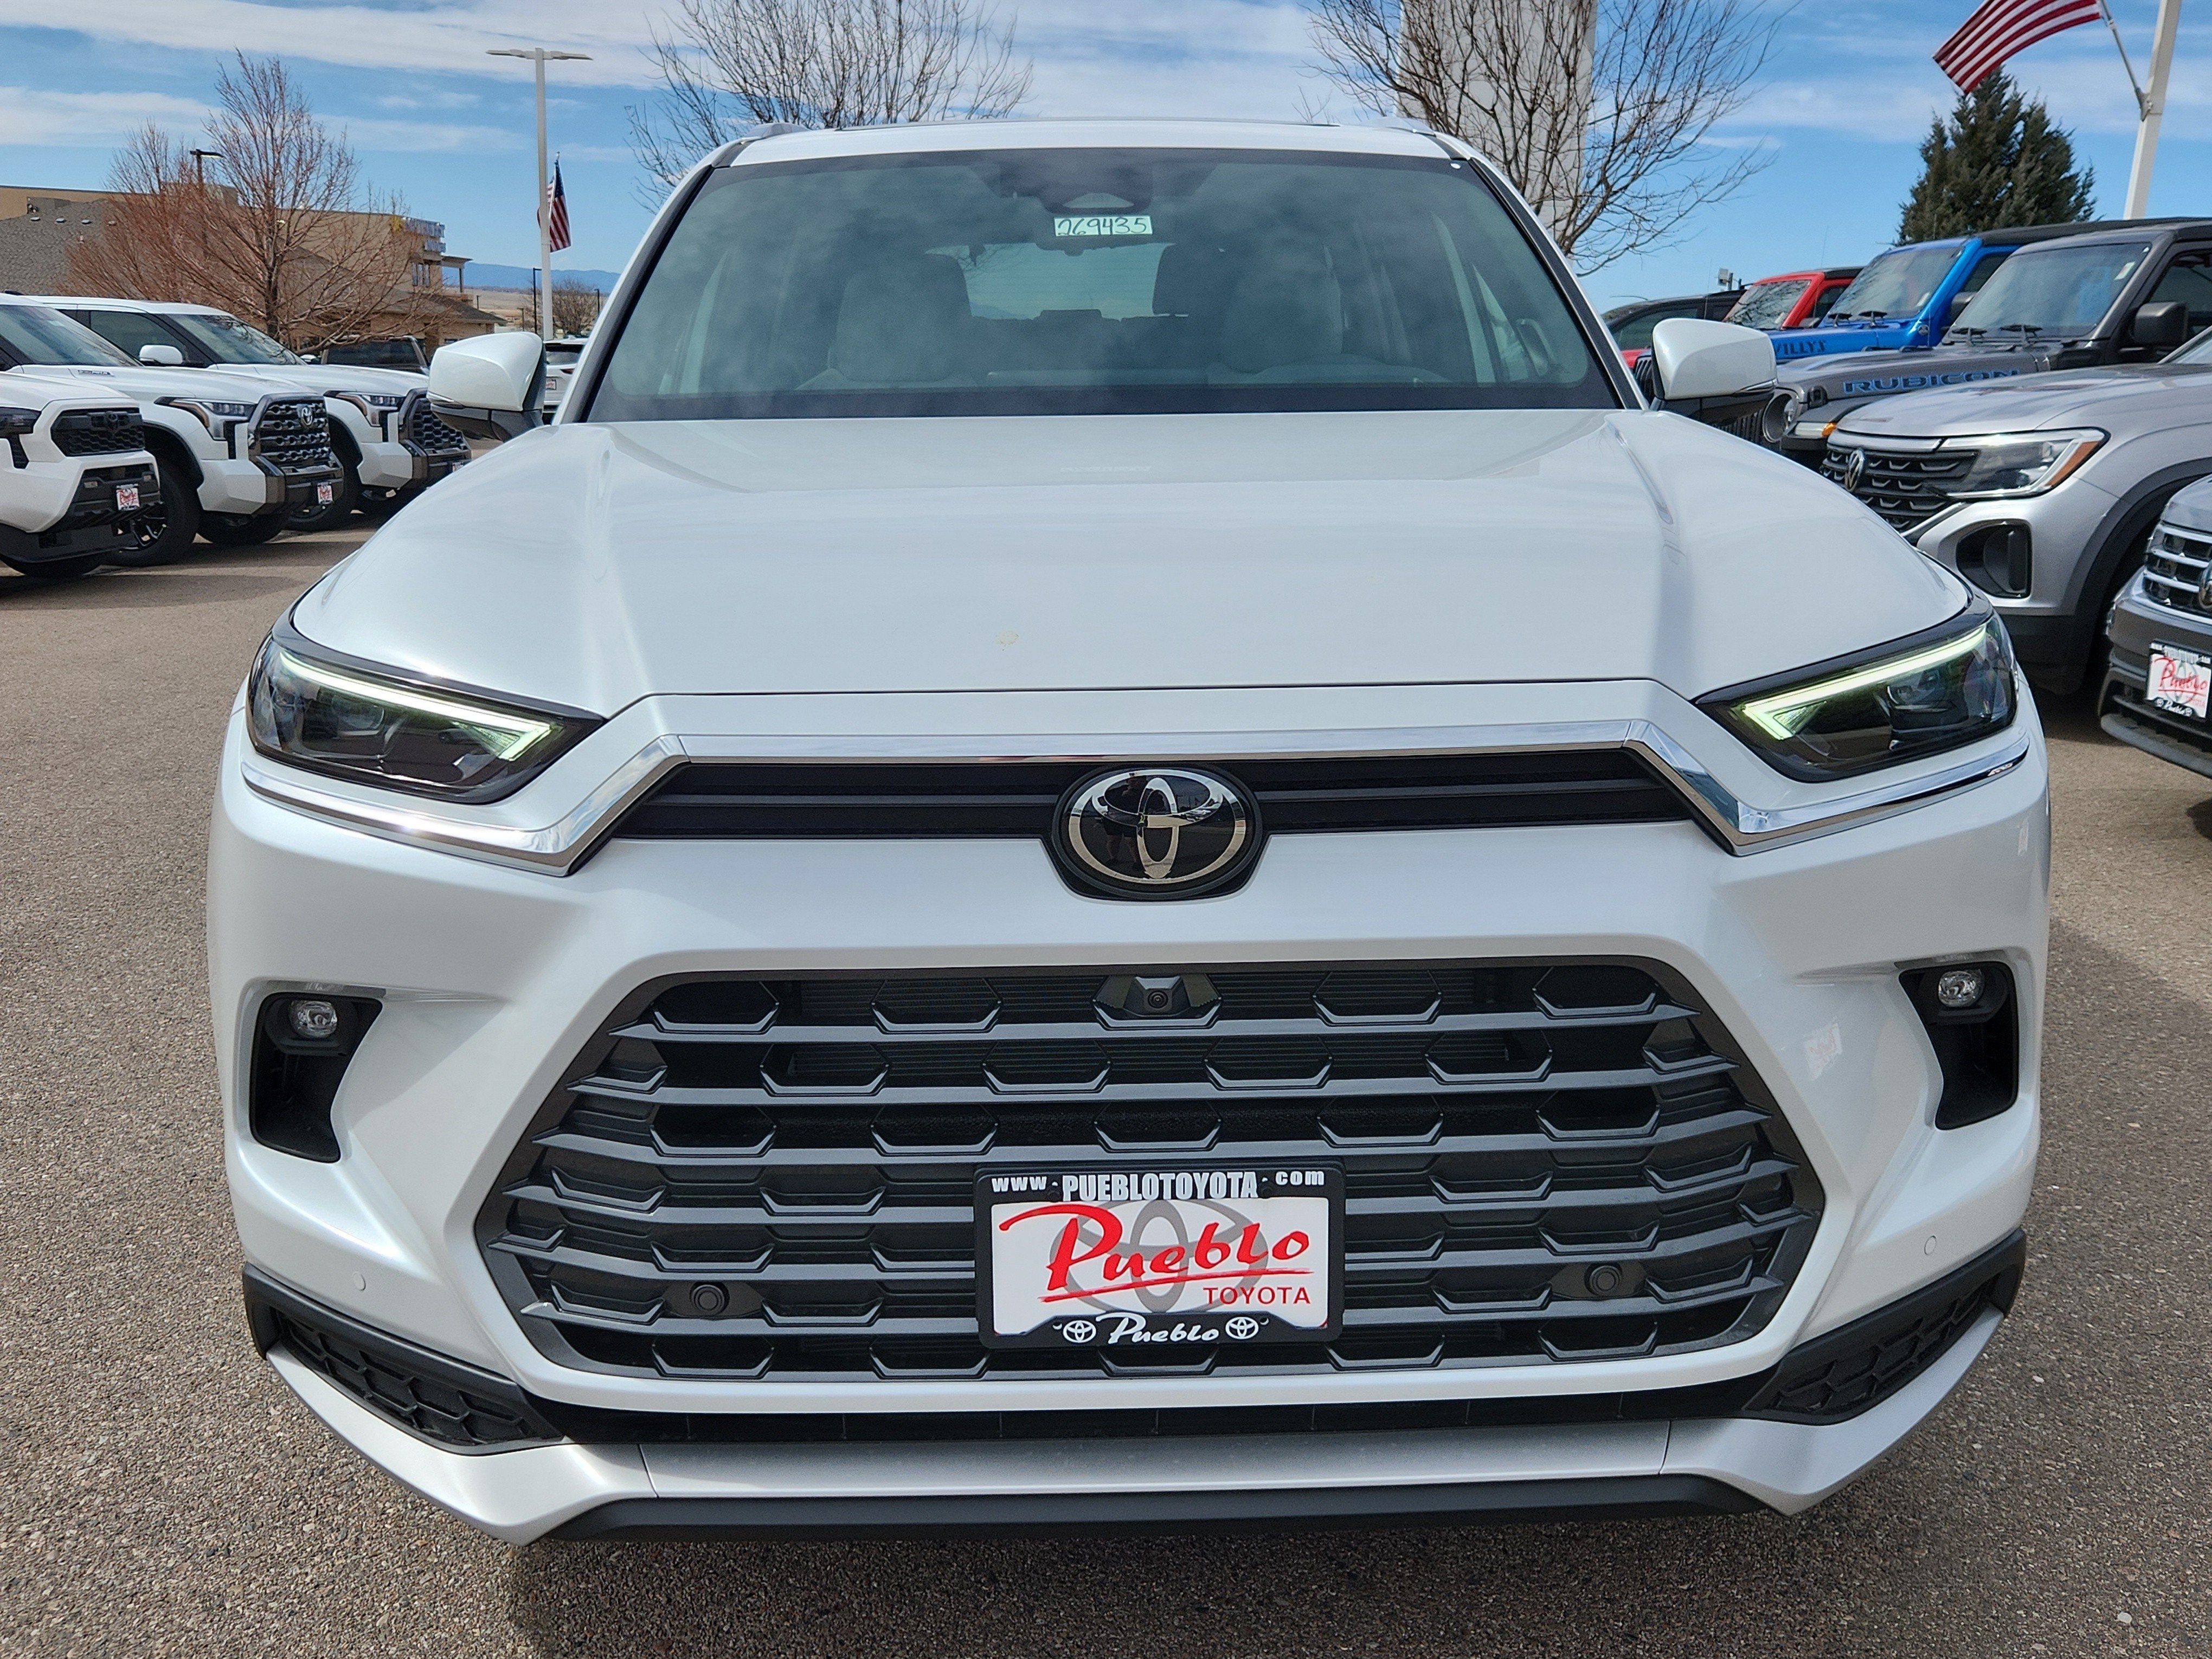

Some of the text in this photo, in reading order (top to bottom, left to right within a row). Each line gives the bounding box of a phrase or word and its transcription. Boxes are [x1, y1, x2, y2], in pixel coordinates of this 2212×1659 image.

[999, 1204, 1310, 1290] Pueblo
[1203, 1287, 1311, 1305] TOYOTA
[1096, 1311, 1219, 1344] Pueblo
